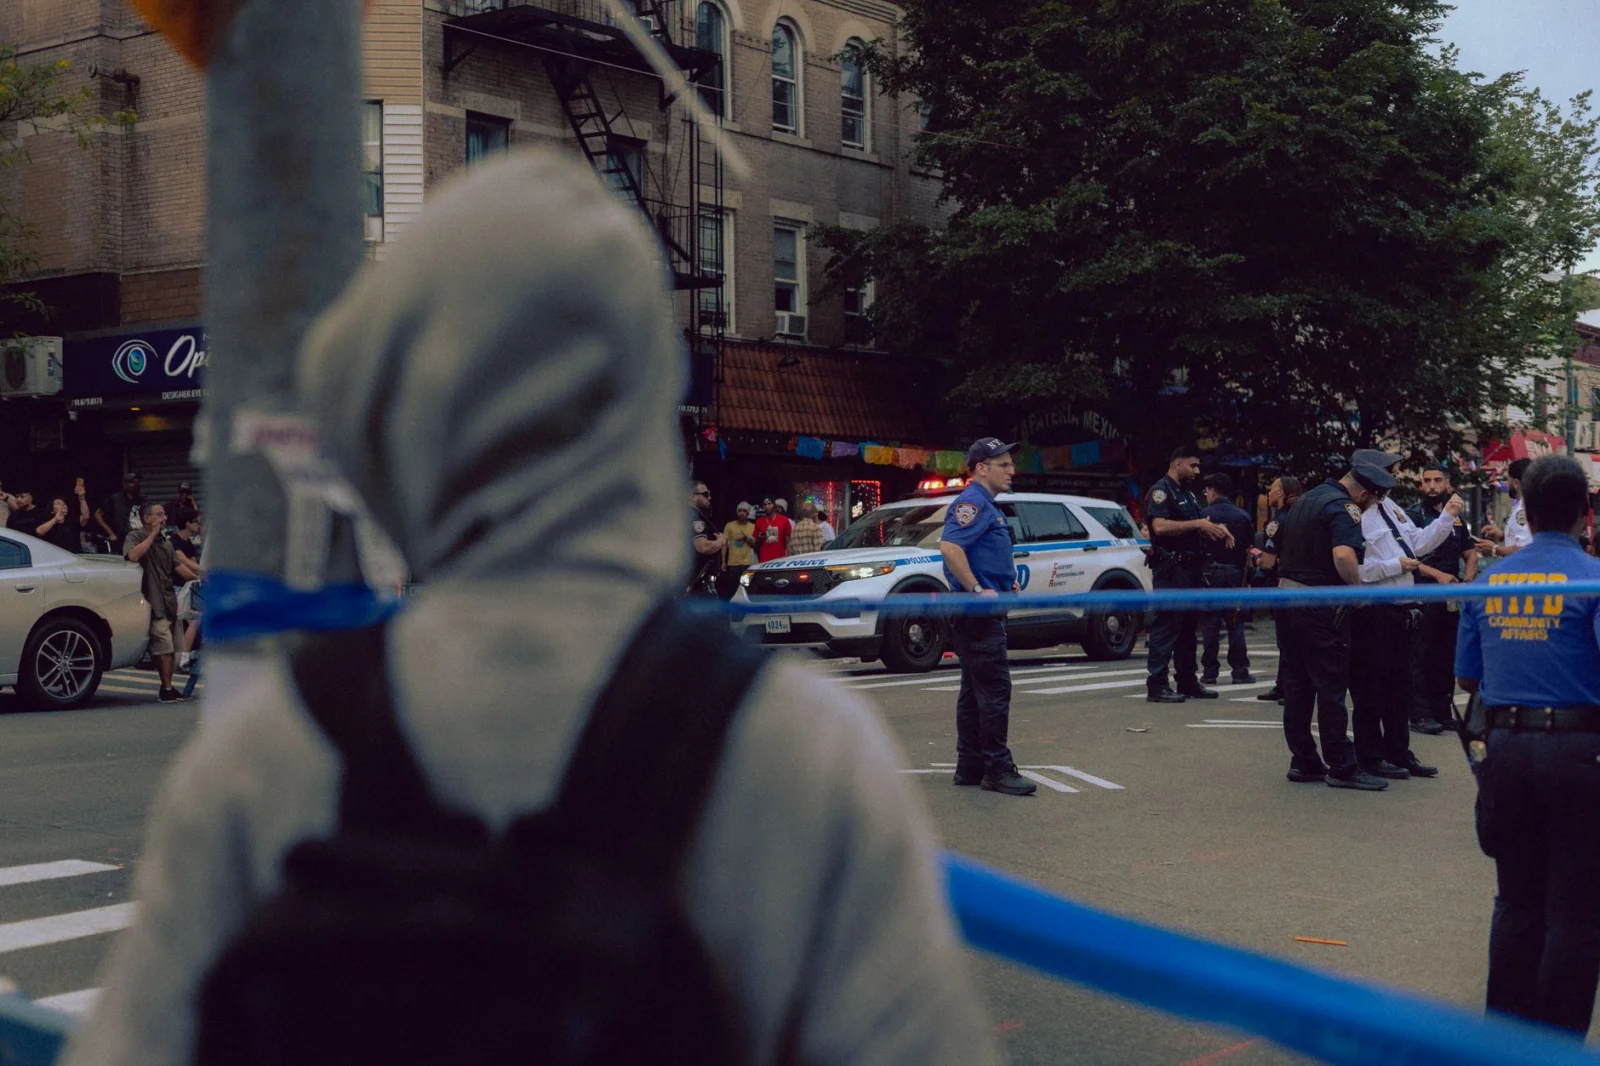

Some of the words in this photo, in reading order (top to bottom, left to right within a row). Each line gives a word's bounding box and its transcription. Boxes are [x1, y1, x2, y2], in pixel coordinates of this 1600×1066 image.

[787, 559, 828, 567] POLICE
[904, 556, 931, 565] POLICE
[1485, 573, 1568, 614] NYPD
[1488, 616, 1560, 628] COMMUNITY
[1500, 628, 1548, 640] AFFAIRS
